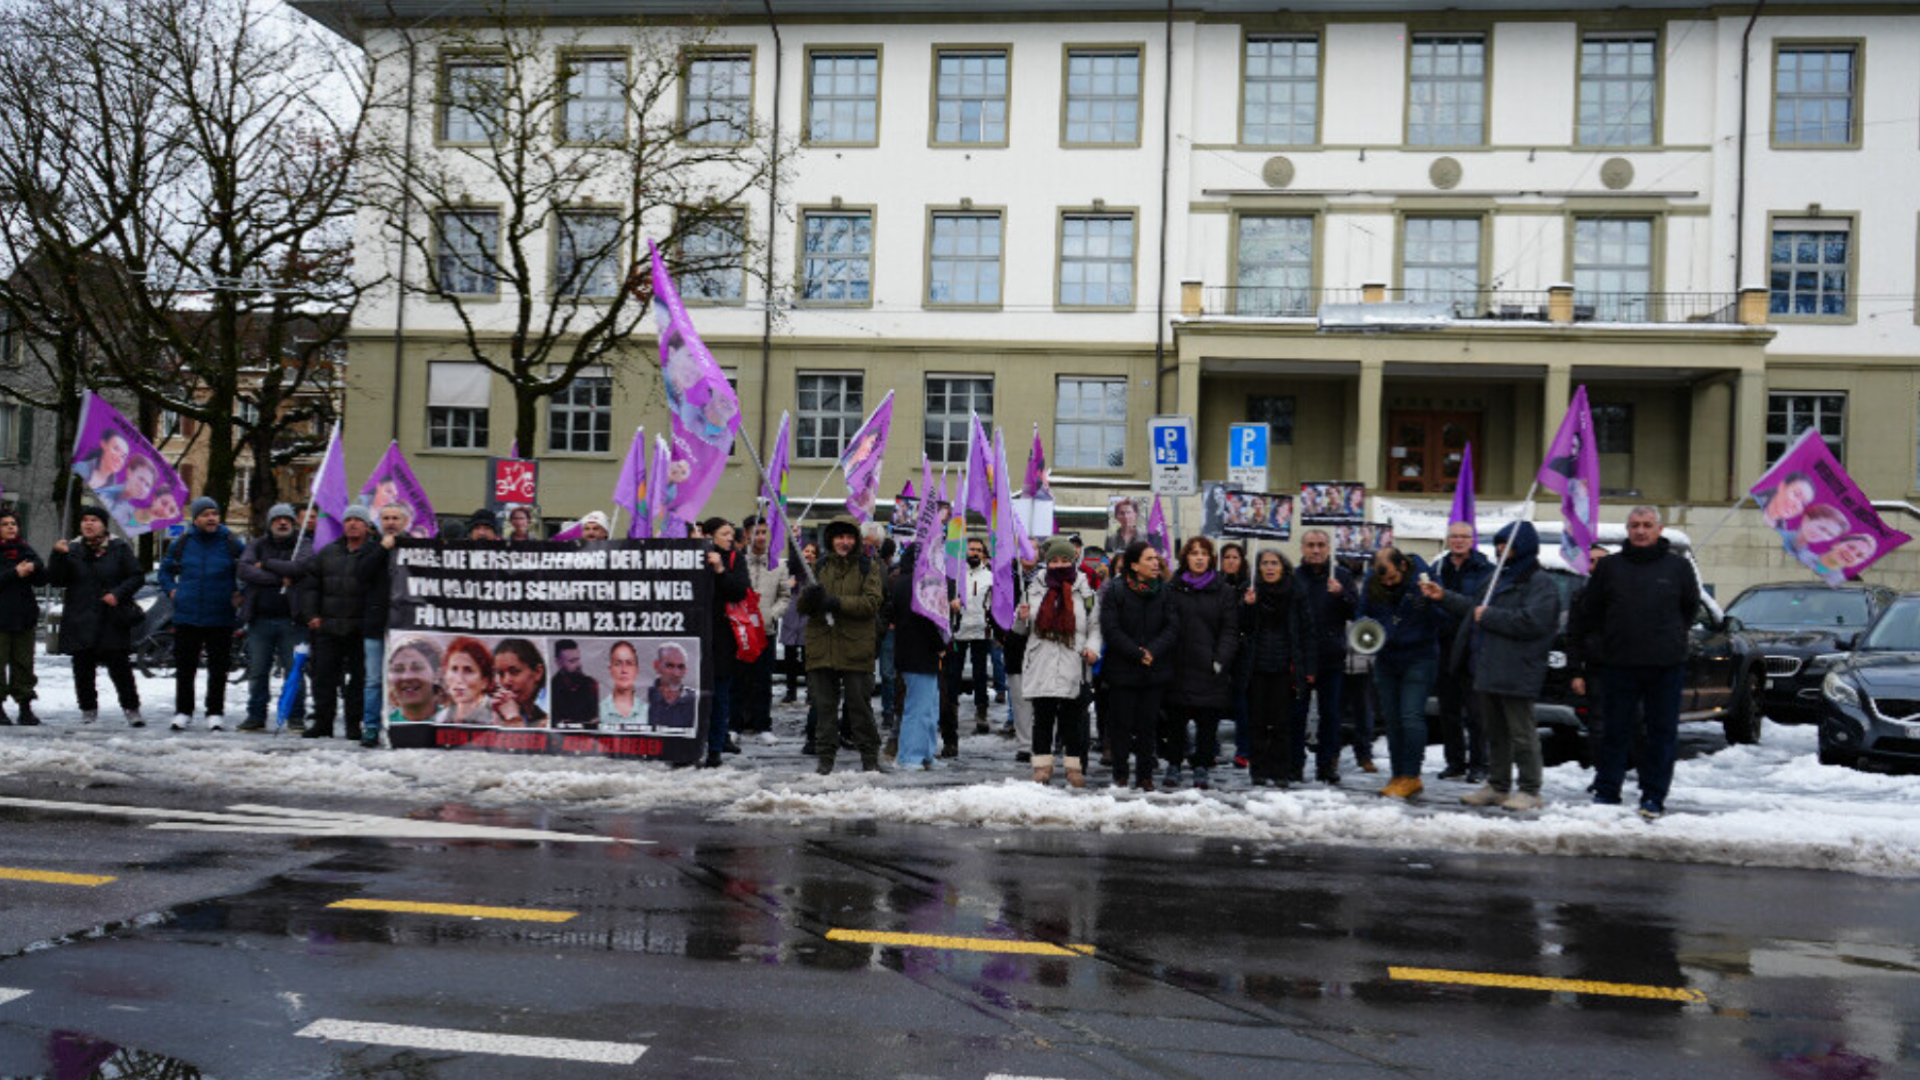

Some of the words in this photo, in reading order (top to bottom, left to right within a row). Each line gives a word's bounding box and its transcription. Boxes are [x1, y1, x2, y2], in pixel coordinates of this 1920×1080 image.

[1164, 428, 1178, 449] P
[1242, 428, 1256, 449] P
[442, 549, 467, 569] DIE
[610, 550, 643, 570] DER
[525, 580, 616, 601] SCHAFFTEN
[653, 581, 694, 601] WEG
[478, 609, 562, 632] MASSAKER
[564, 611, 591, 631] AM
